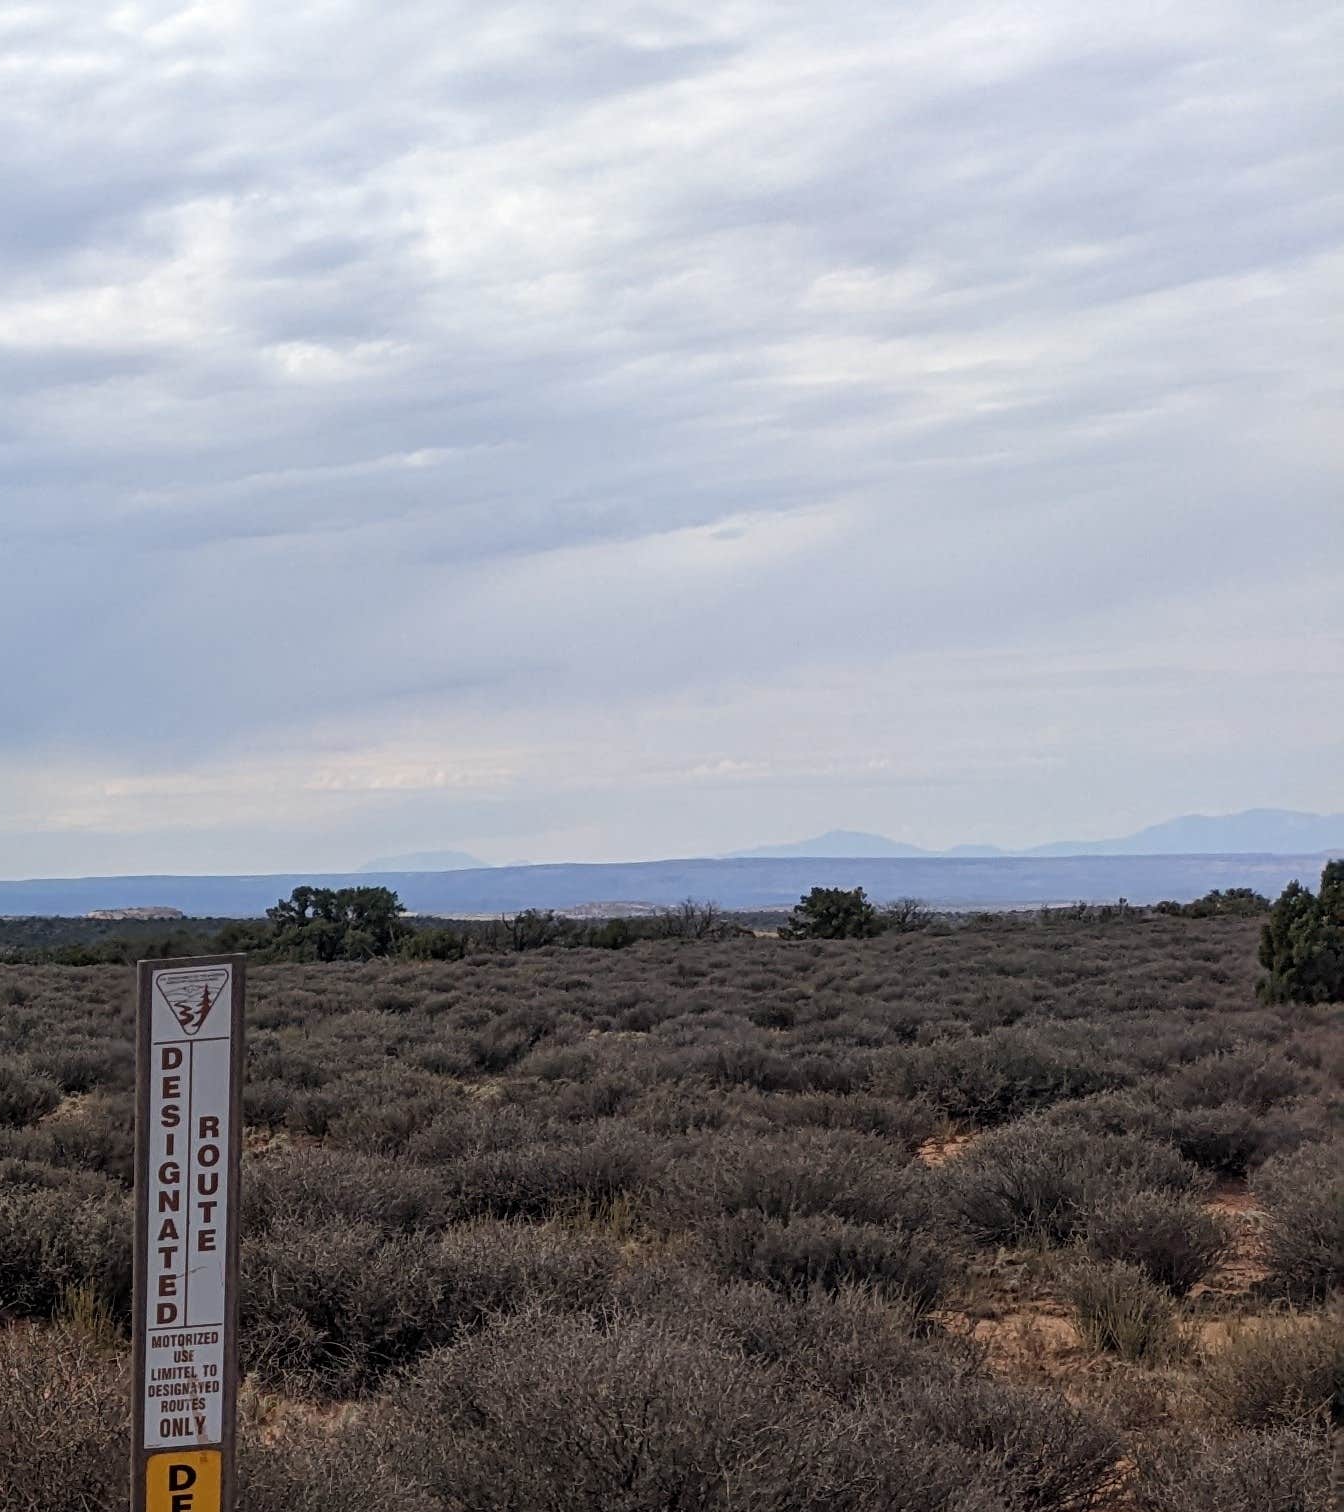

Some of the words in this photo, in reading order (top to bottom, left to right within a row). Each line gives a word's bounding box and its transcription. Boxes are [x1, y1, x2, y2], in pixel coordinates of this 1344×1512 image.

[157, 1047, 183, 1324] DESIGNATED
[197, 1116, 220, 1252] ROUTE
[151, 1331, 219, 1349] MOTORIZED
[173, 1350, 195, 1363] USE
[203, 1364, 217, 1378] TO
[148, 1380, 220, 1398] DESIGNATED
[160, 1398, 206, 1413] ROUTES
[159, 1415, 207, 1438] ONLY
